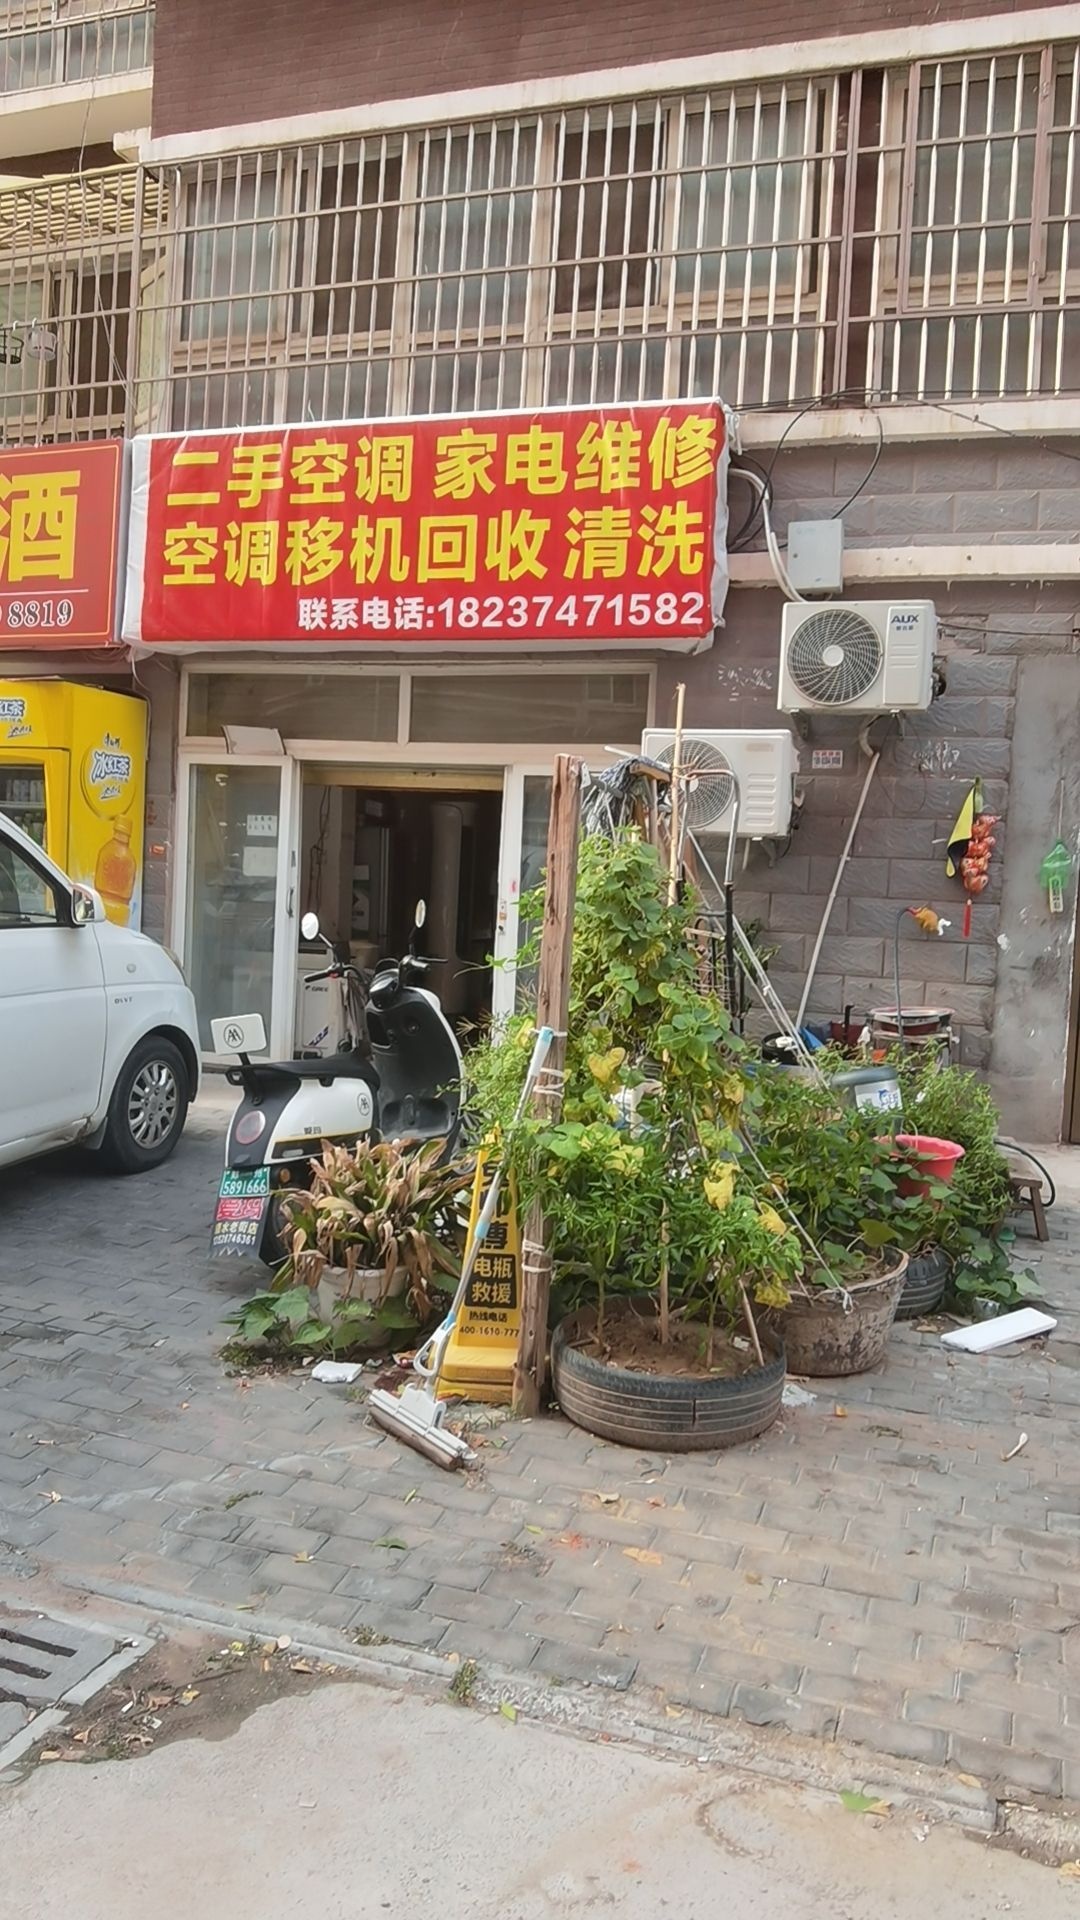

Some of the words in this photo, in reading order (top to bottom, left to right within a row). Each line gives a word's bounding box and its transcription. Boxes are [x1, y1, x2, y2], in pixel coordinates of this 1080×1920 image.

[167, 435, 412, 508] 二手空调
[434, 415, 716, 500] 家电维修
[0, 470, 81, 582] 酒
[163, 500, 705, 587] 空调移机回收清洗
[8, 599, 74, 628] 8819
[890, 614, 920, 624] AUX
[223, 1180, 266, 1194] 5891666
[473, 1255, 513, 1279] 电瓶
[471, 1281, 512, 1304] 救援
